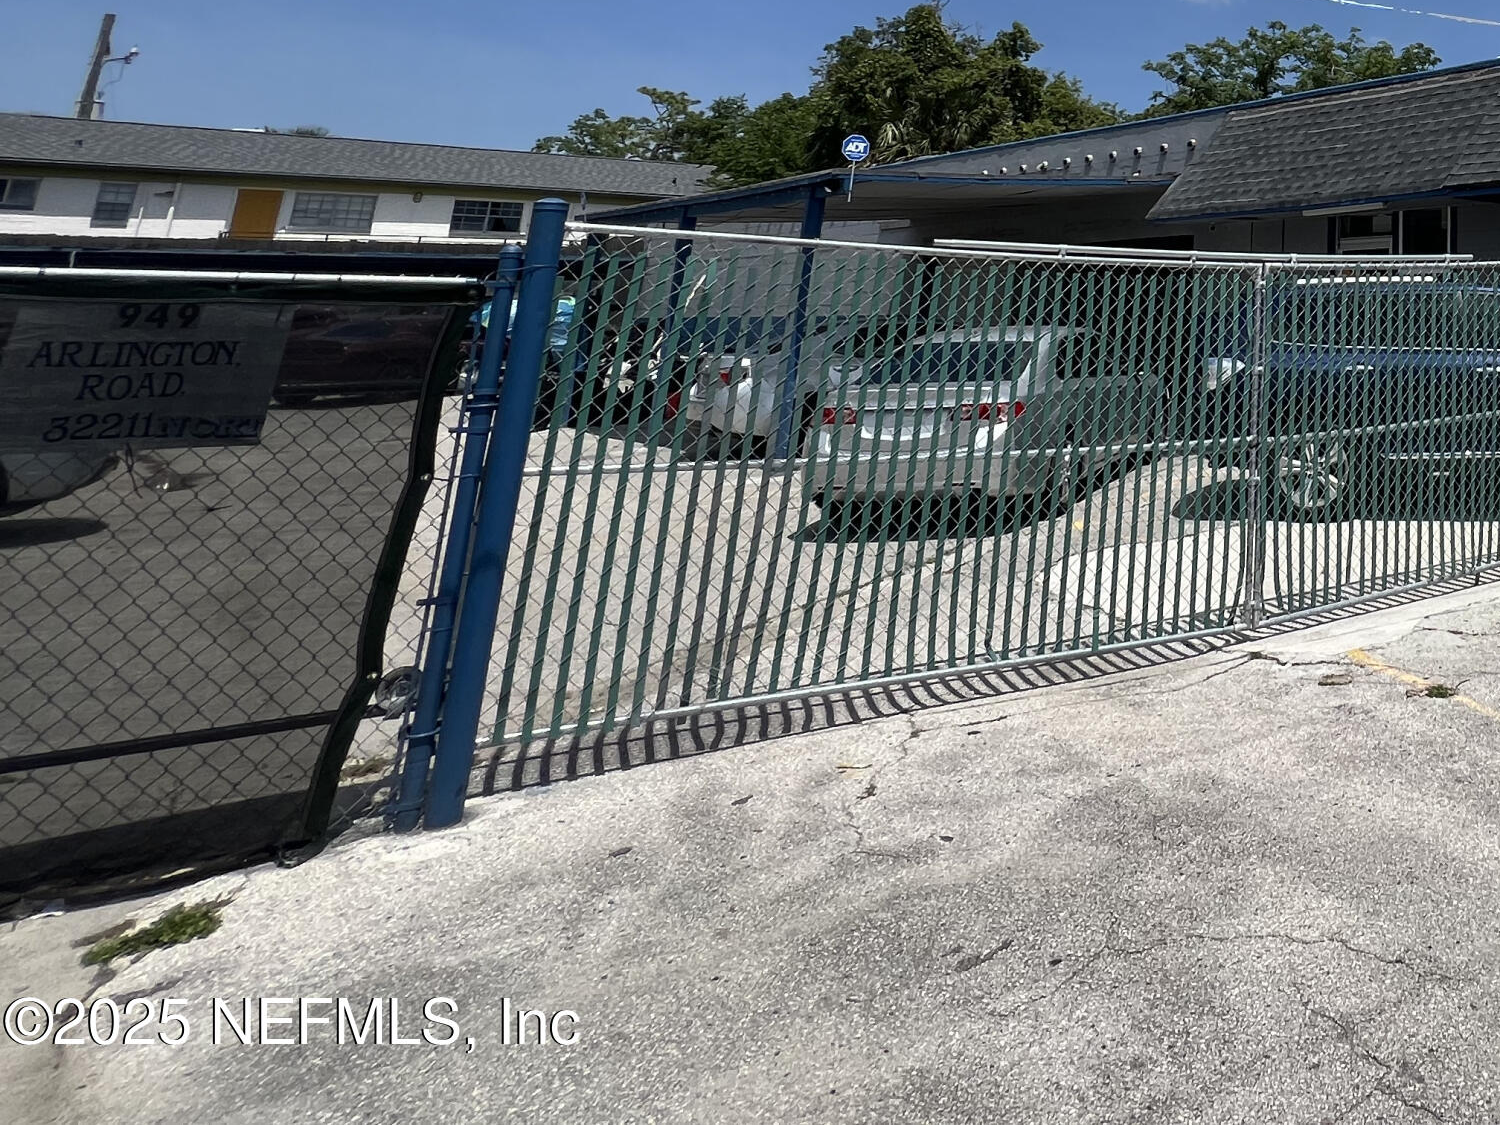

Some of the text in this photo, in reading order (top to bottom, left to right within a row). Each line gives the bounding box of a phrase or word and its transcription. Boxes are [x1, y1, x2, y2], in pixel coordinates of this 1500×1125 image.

[845, 141, 868, 153] ADT
[118, 303, 201, 328] 949
[42, 411, 153, 443] 32211
